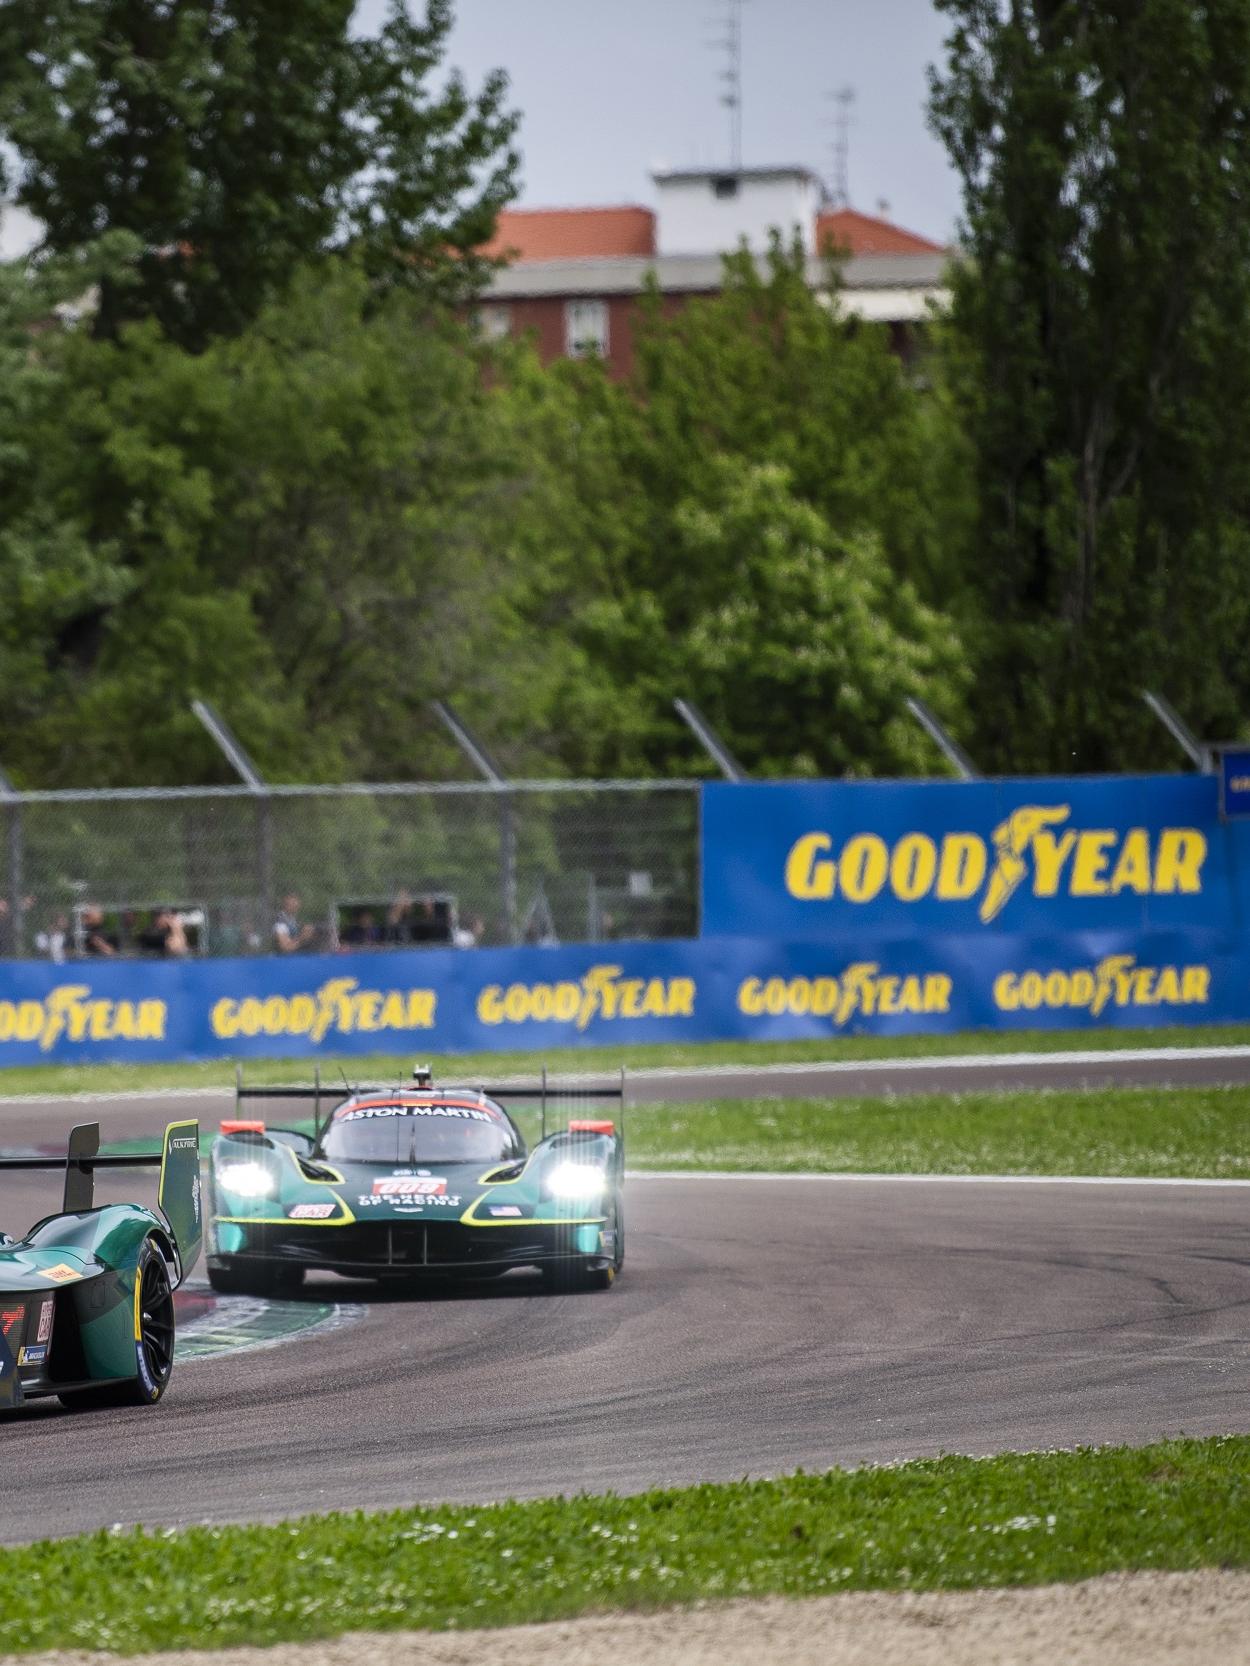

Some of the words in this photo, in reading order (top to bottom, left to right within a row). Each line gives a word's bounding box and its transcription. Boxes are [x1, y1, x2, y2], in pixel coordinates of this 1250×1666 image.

[785, 818, 1208, 906] GOODYEAR
[477, 974, 695, 1026] GOODYEAR
[738, 970, 952, 1018] GOODYEAR
[993, 963, 1210, 1011] GOODYEAR
[211, 987, 436, 1038] GOODYEAR
[341, 1107, 408, 1122] ASTON
[413, 1106, 492, 1122] MARTIN
